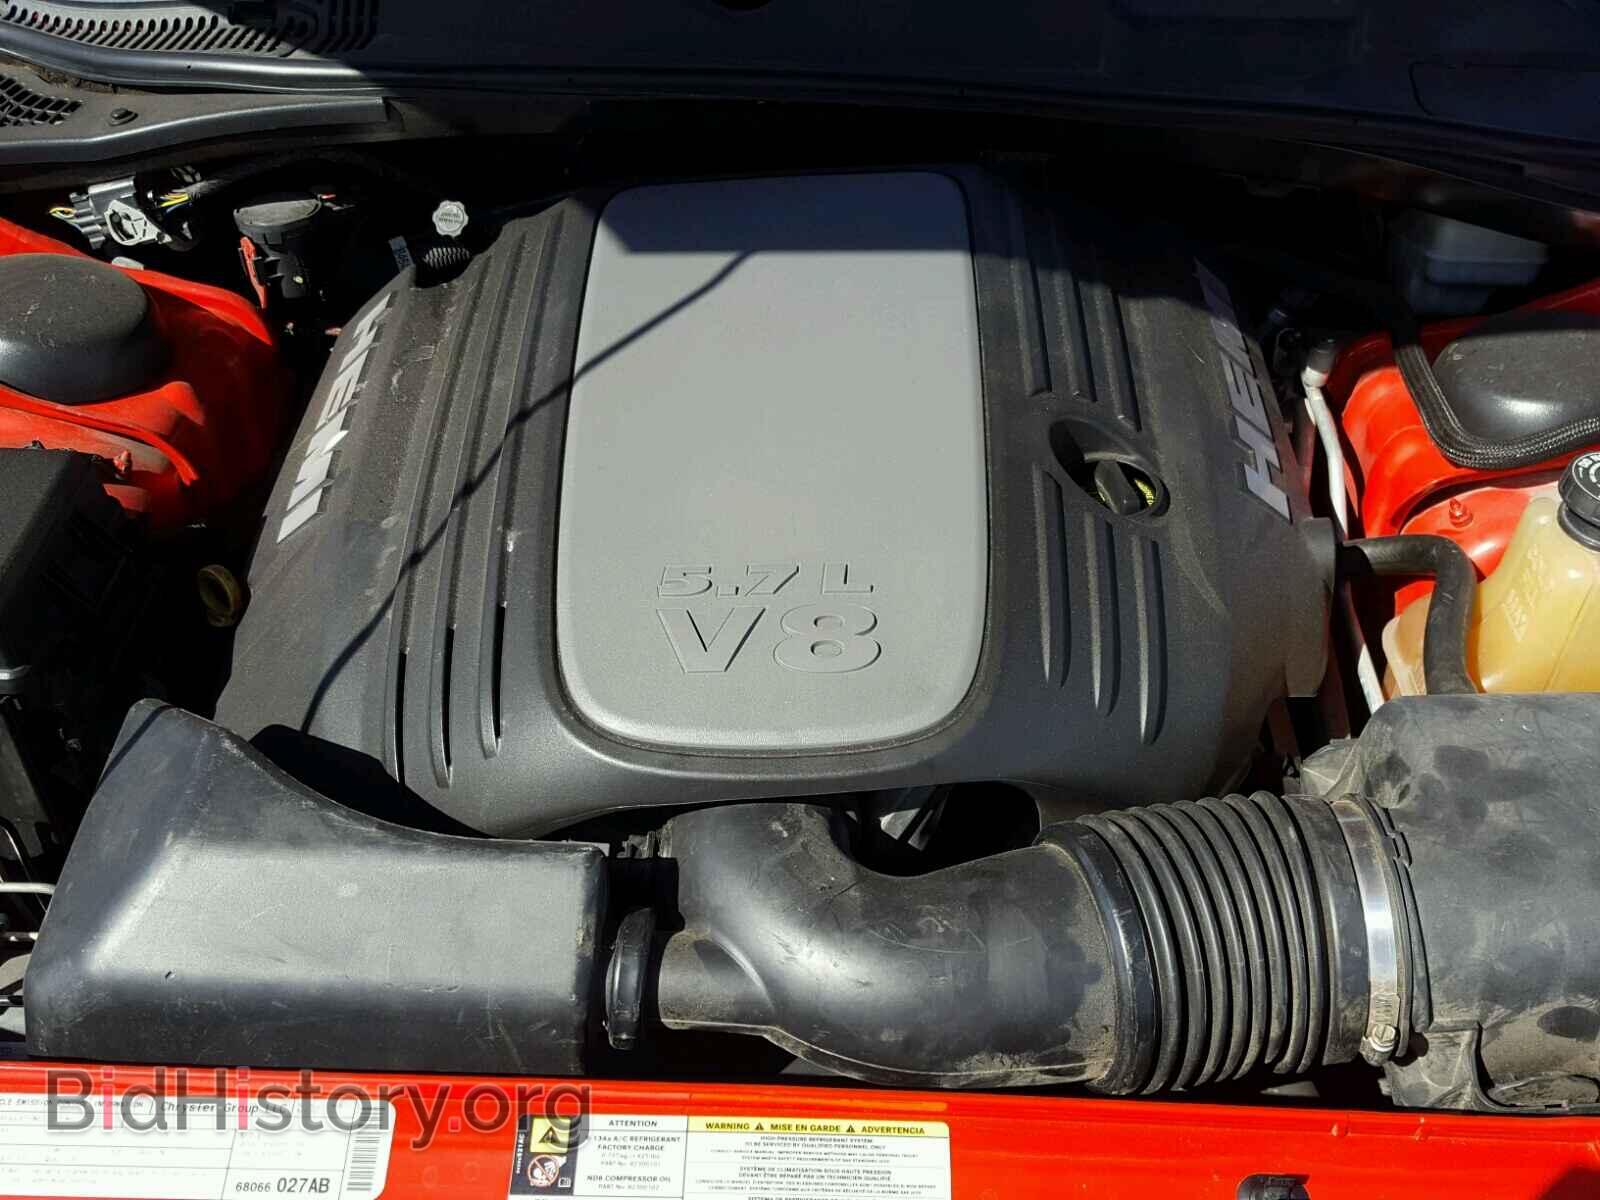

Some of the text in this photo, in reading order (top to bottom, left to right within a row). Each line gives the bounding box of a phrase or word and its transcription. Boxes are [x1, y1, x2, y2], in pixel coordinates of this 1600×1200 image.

[276, 293, 391, 543] HEMI
[657, 562, 874, 599] 5.7 L
[656, 603, 882, 674] V8
[608, 1119, 658, 1127] ATTENTION
[705, 1121, 750, 1130] WARNING
[770, 1123, 792, 1131] MISE
[810, 1124, 841, 1132] GARDE
[861, 1125, 925, 1135] ADVERTENCIA
[235, 1178, 330, 1193] 68066 027AB
